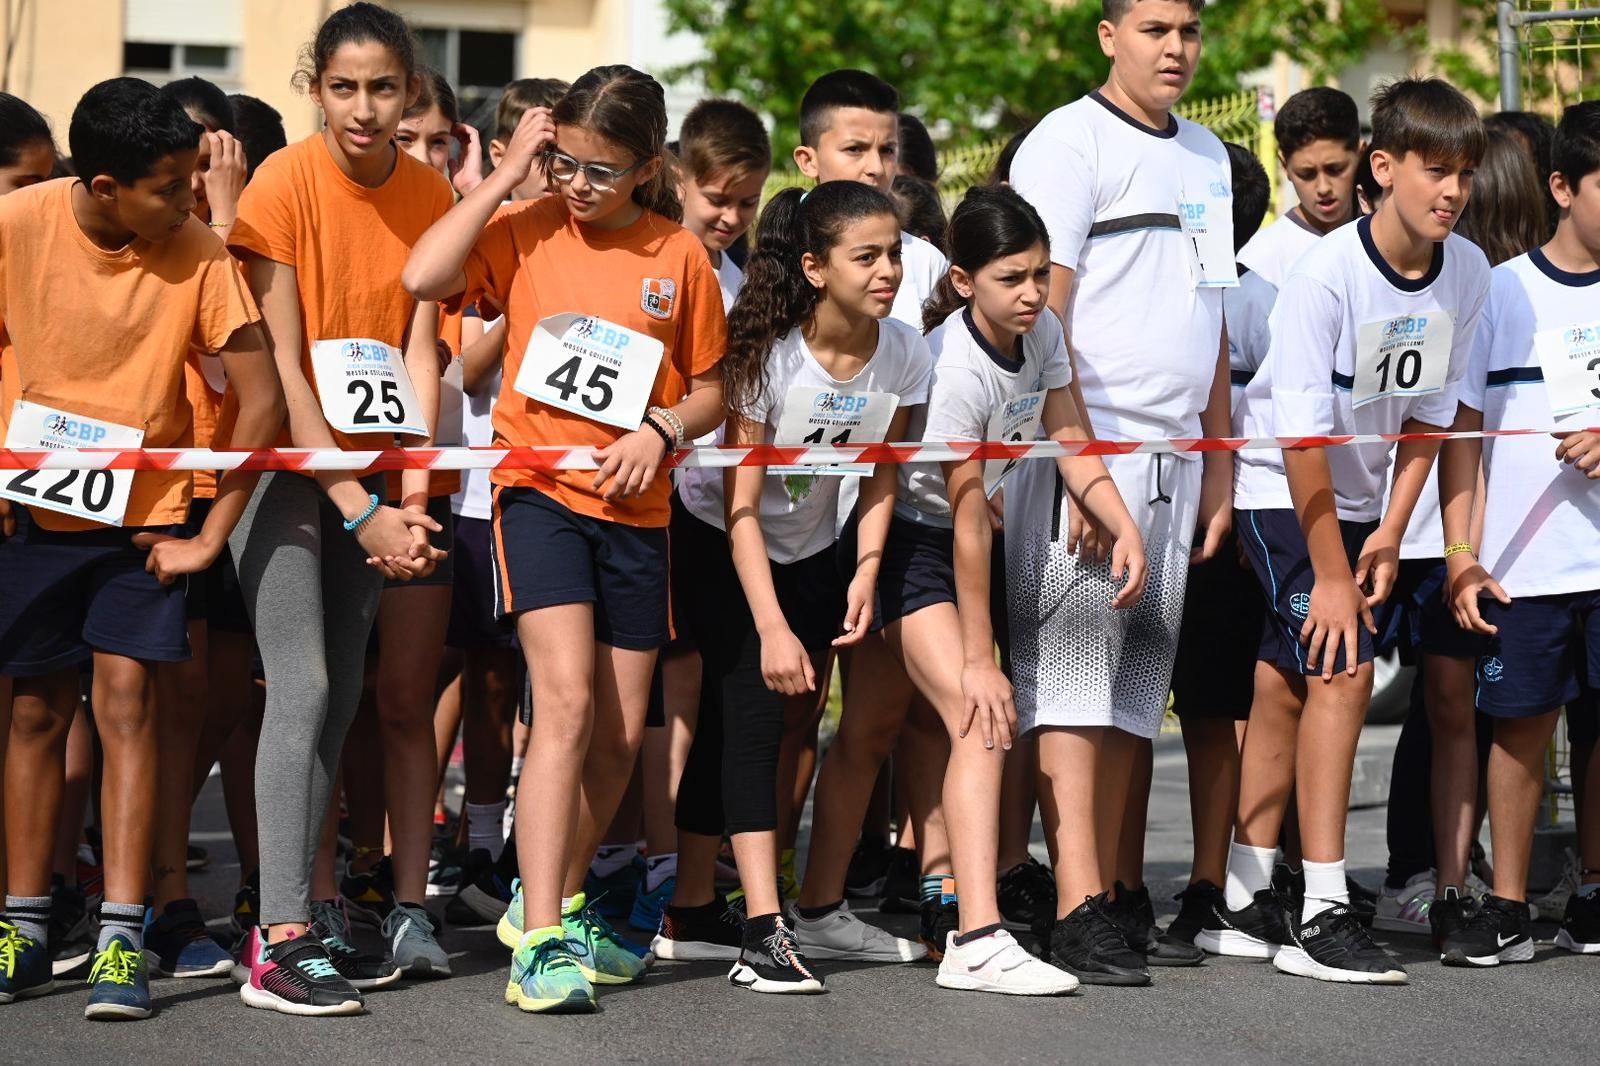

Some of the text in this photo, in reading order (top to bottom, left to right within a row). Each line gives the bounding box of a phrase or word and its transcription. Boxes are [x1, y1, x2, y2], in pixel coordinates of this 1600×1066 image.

[592, 323, 630, 349] CBP
[1396, 318, 1428, 334] CBP
[363, 343, 389, 361] CBP
[589, 350, 623, 367] GUILLERMO
[1375, 349, 1422, 393] 10
[545, 355, 619, 412] 45
[347, 379, 405, 424] 25
[832, 395, 868, 412] CBP
[65, 420, 107, 443] CBP
[5, 468, 115, 513] 220
[1300, 925, 1321, 941] FILA
